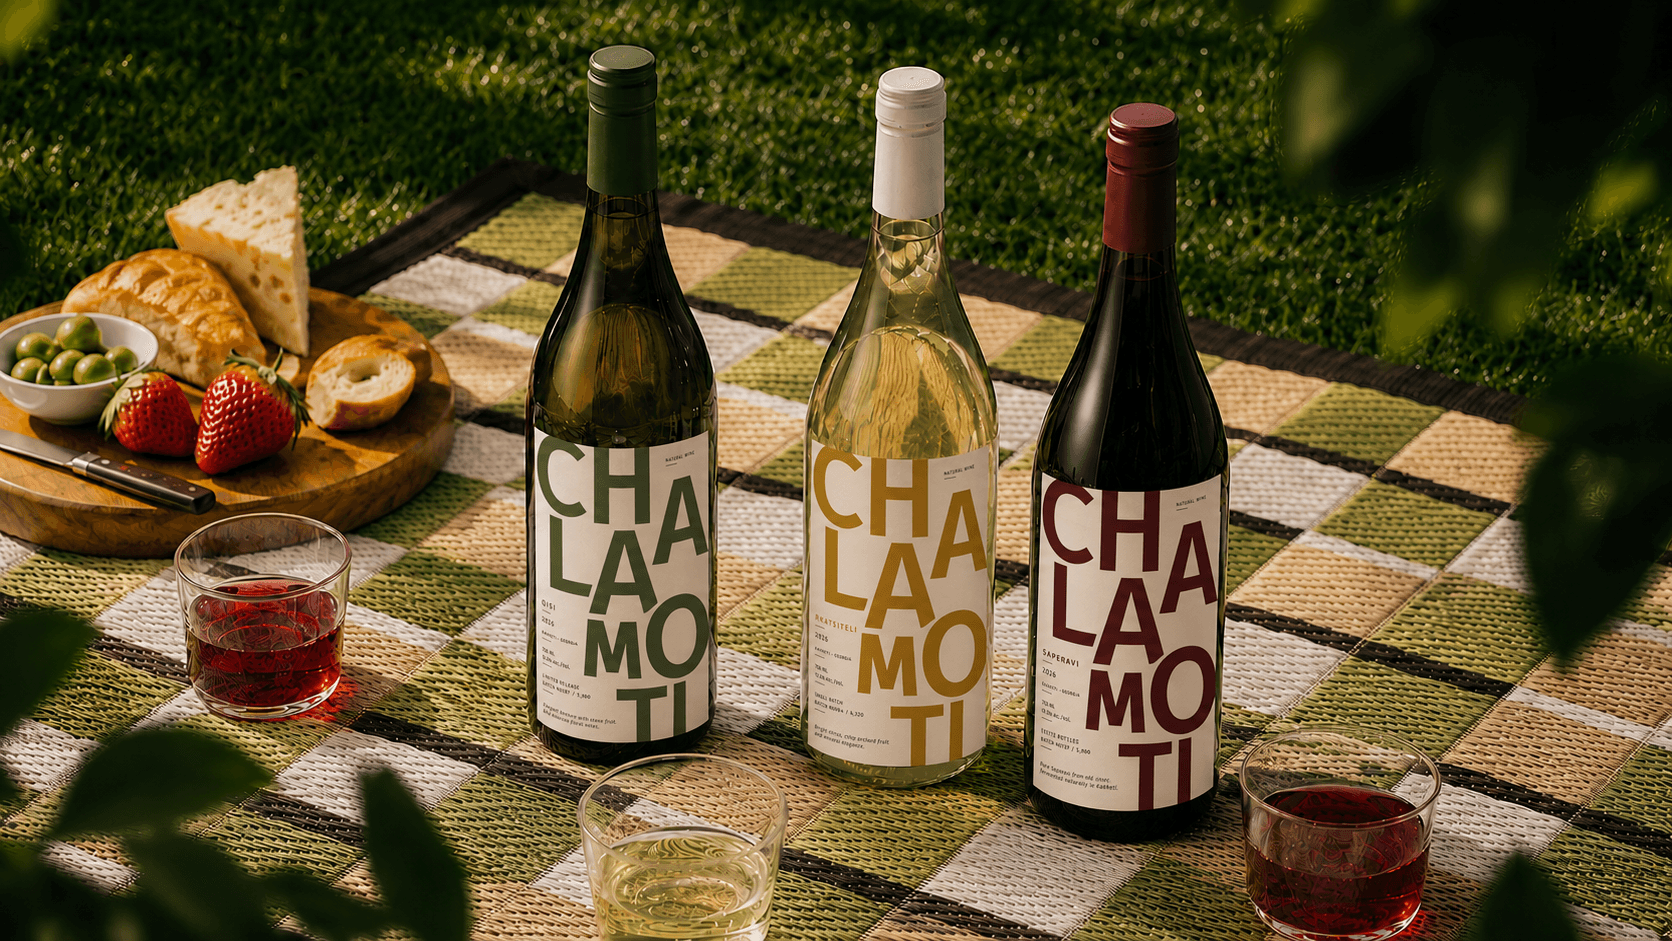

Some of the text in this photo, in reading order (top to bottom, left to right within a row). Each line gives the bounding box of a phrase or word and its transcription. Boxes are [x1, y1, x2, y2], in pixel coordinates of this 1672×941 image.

[541, 599, 556, 611] QISI
[814, 613, 858, 633] RKATSITELI
[1042, 648, 1079, 667] SAPERAVI
